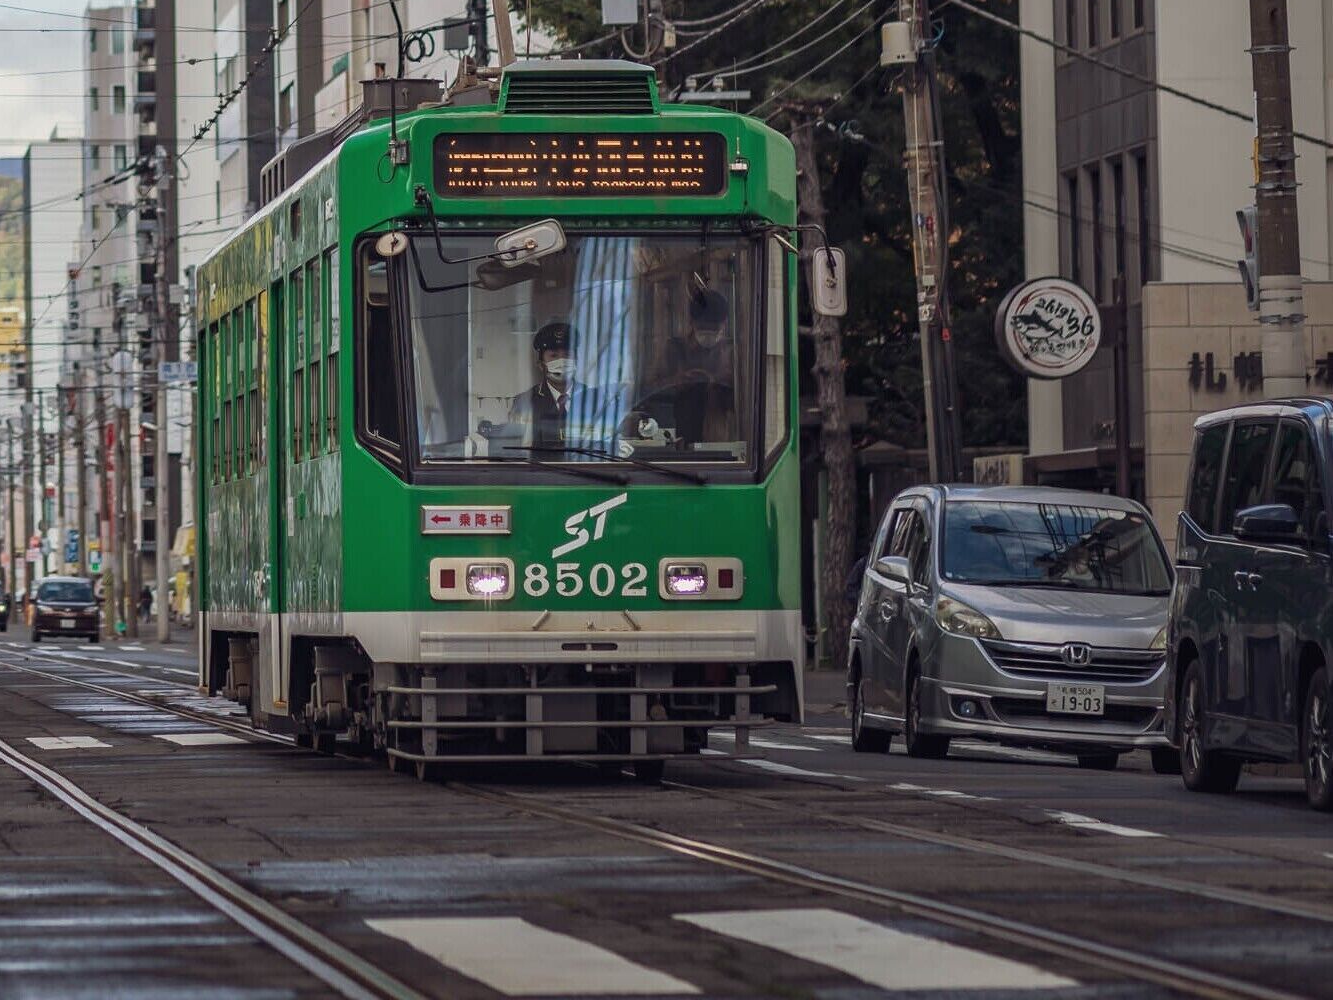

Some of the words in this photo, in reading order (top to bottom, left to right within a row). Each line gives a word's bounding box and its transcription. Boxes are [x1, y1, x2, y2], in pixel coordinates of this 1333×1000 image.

[459, 513, 503, 527] 乗降中
[552, 492, 627, 559] ST
[523, 562, 648, 597] 8502
[1061, 696, 1101, 712] 19-03
